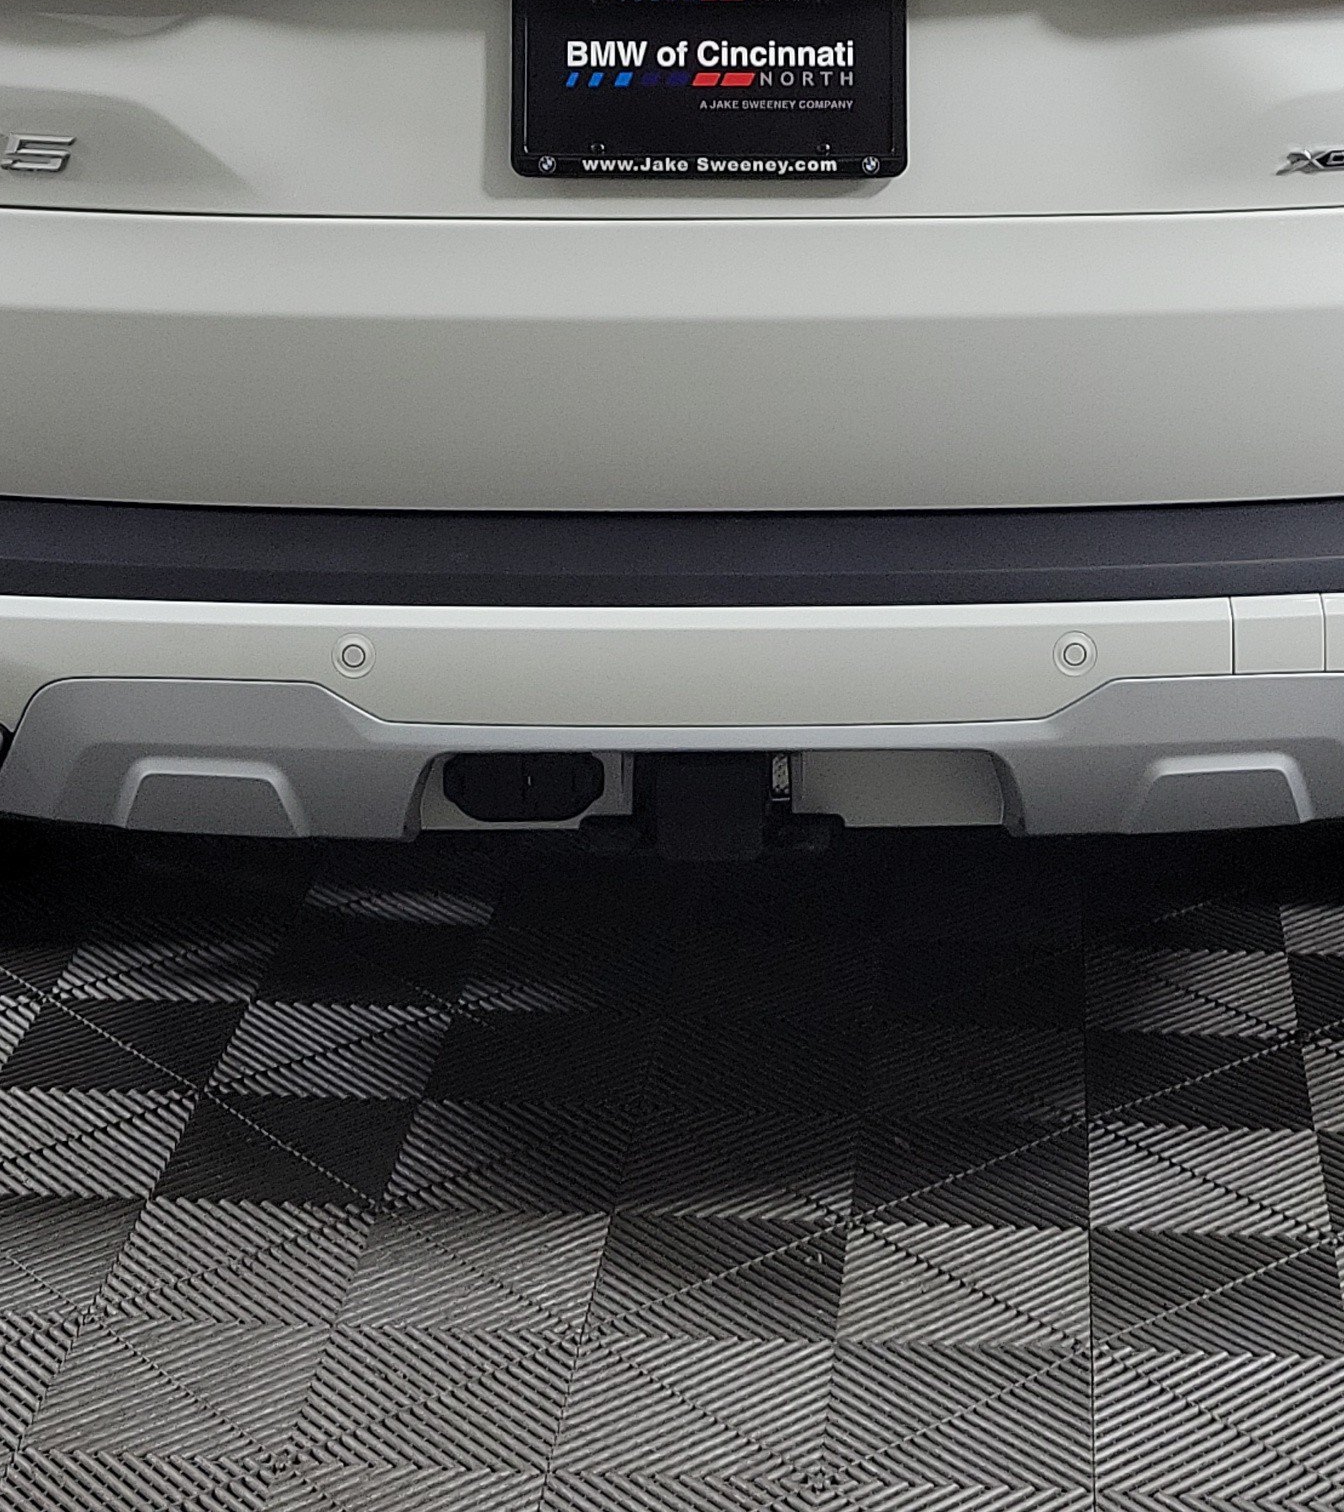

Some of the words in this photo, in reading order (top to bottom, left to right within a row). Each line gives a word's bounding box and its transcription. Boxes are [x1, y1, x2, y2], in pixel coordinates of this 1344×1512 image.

[566, 40, 648, 67] BMW
[656, 40, 688, 67] of
[697, 40, 854, 67] Cincinnati
[759, 71, 854, 87] NORTH
[700, 100, 708, 110] A
[709, 100, 739, 110] JAKE
[742, 100, 796, 110] SWEENEY
[799, 100, 854, 110] COMPANY
[582, 157, 689, 172] www.Jake
[697, 157, 838, 175] Sweeney.com
